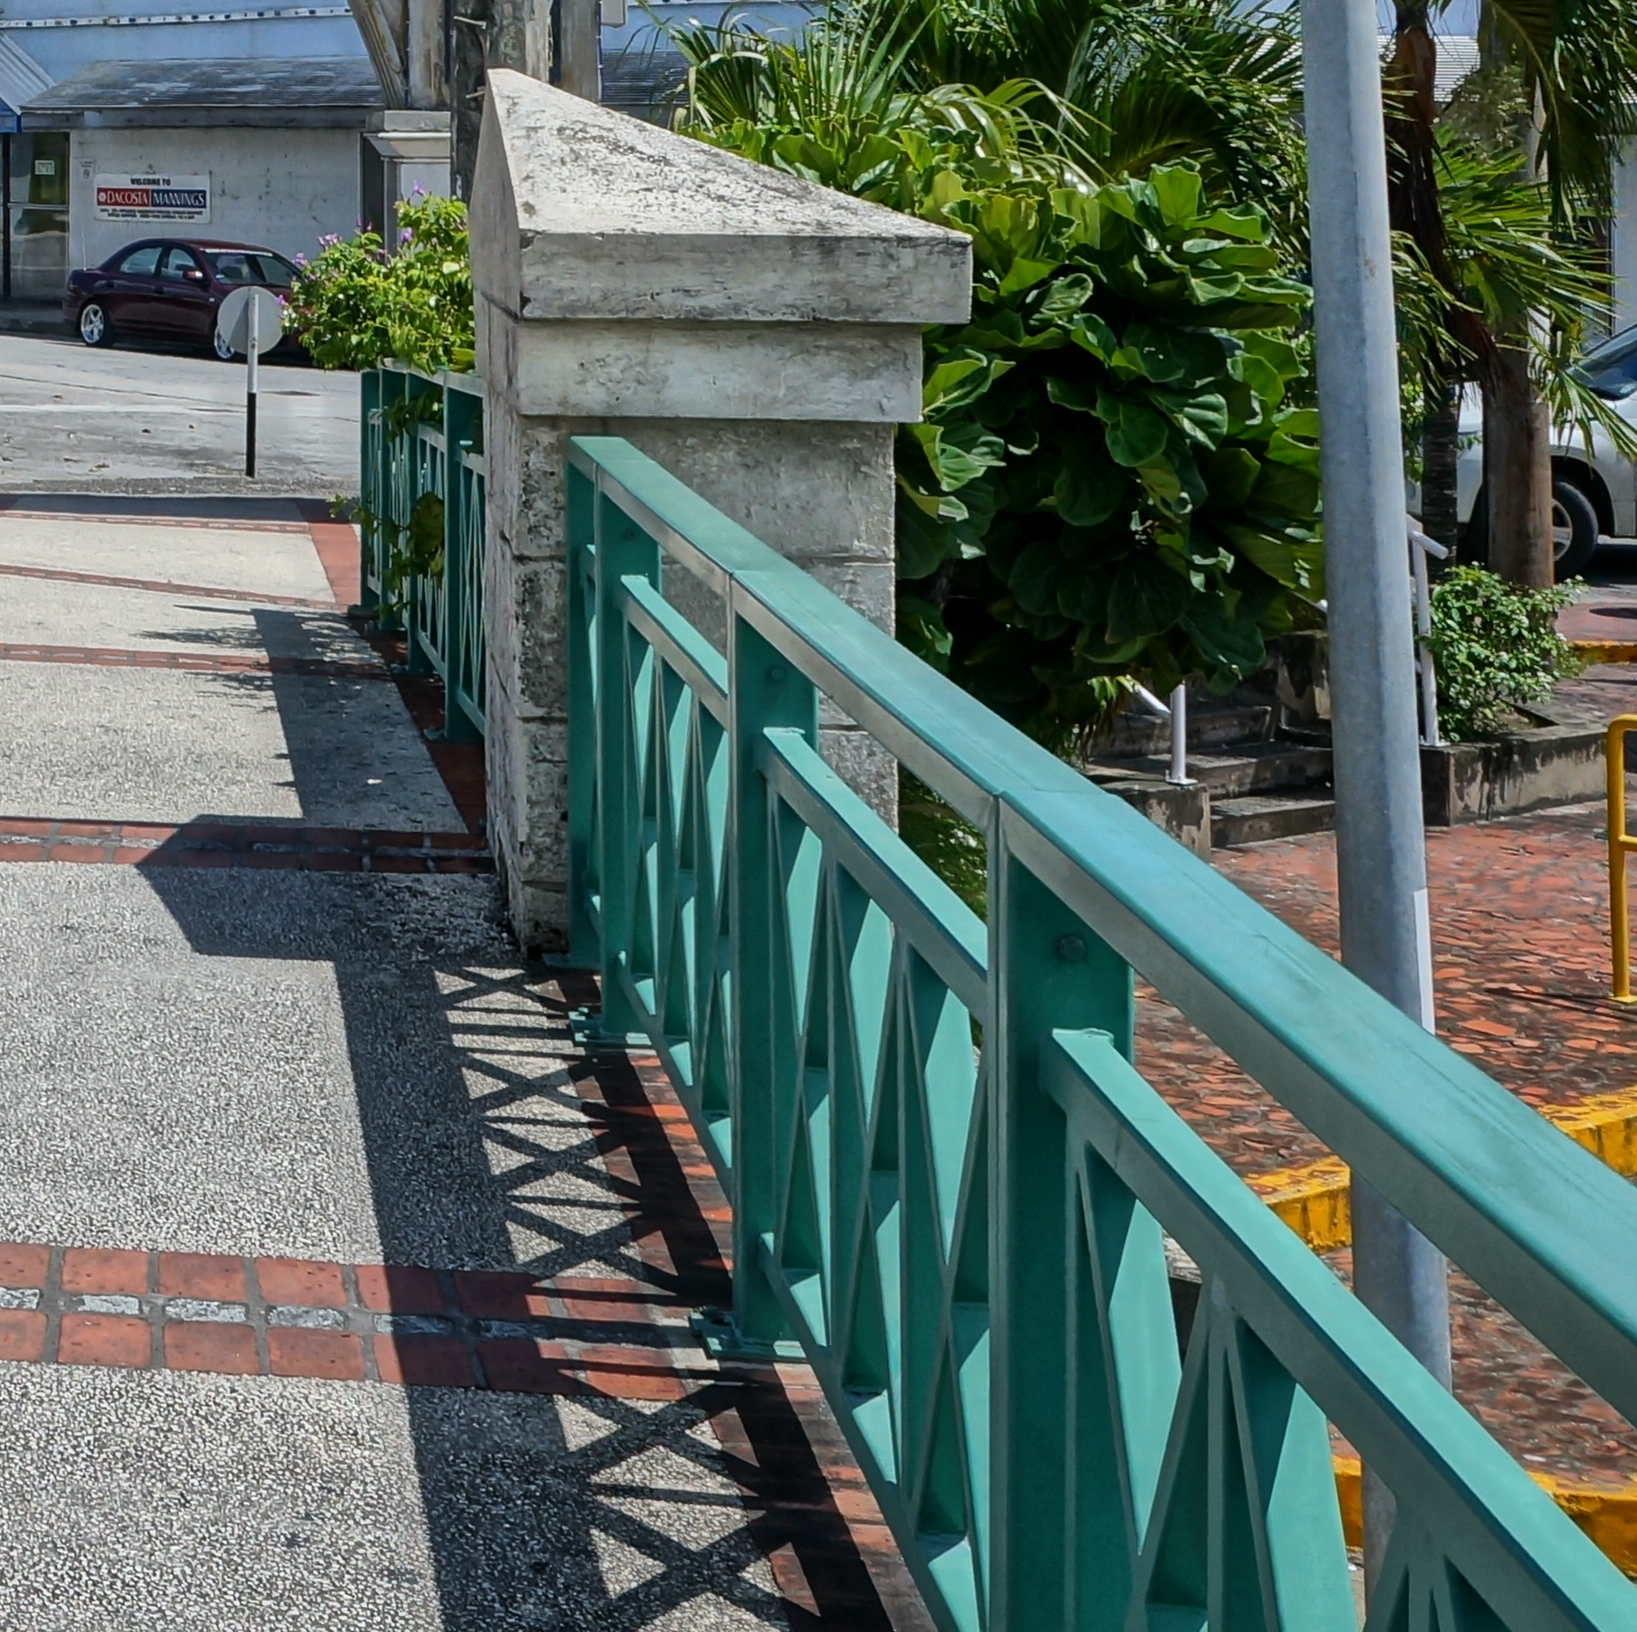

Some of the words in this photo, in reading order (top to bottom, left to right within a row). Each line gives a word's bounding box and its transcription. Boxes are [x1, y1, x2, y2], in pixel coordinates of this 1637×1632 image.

[130, 178, 160, 186] WELCOME
[162, 178, 171, 186] TO
[107, 191, 149, 204] DACOSTA
[153, 192, 205, 206] MANNINGS
